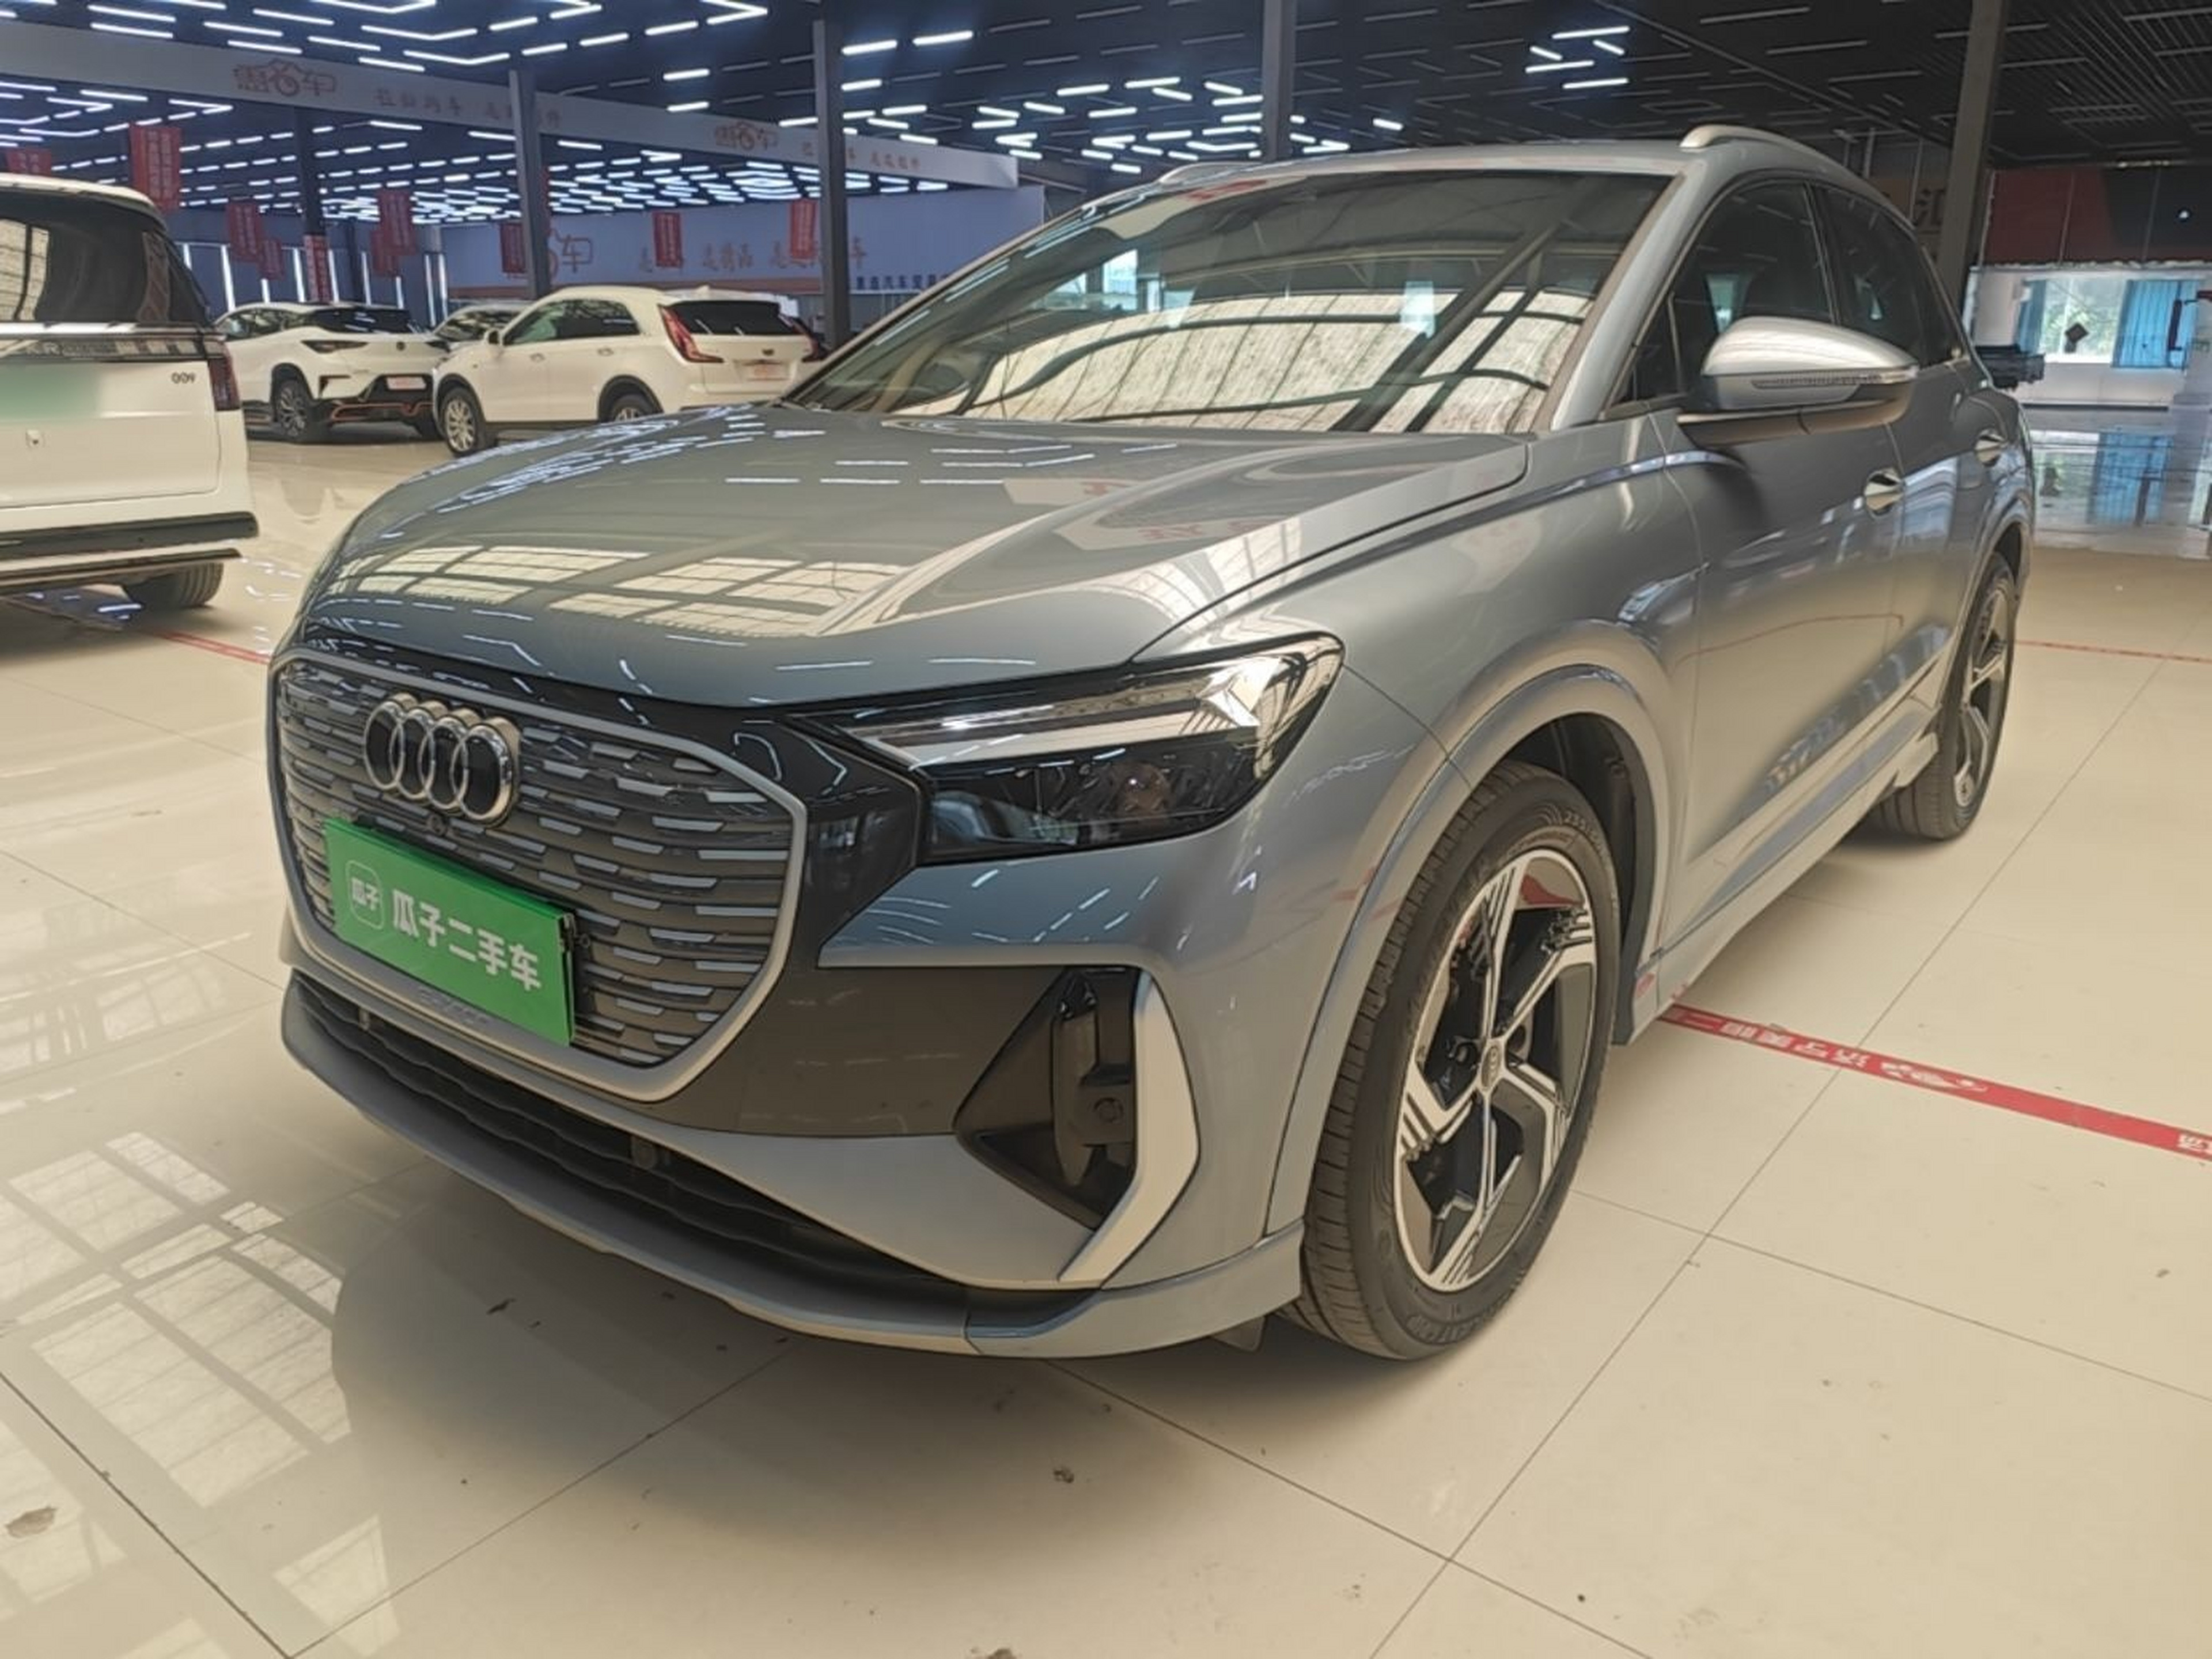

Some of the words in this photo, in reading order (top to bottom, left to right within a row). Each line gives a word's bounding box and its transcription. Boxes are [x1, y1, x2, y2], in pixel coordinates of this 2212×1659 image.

[171, 372, 196, 384] 009
[351, 877, 380, 911] 瓜子
[393, 888, 541, 991] 瓜子二手车
